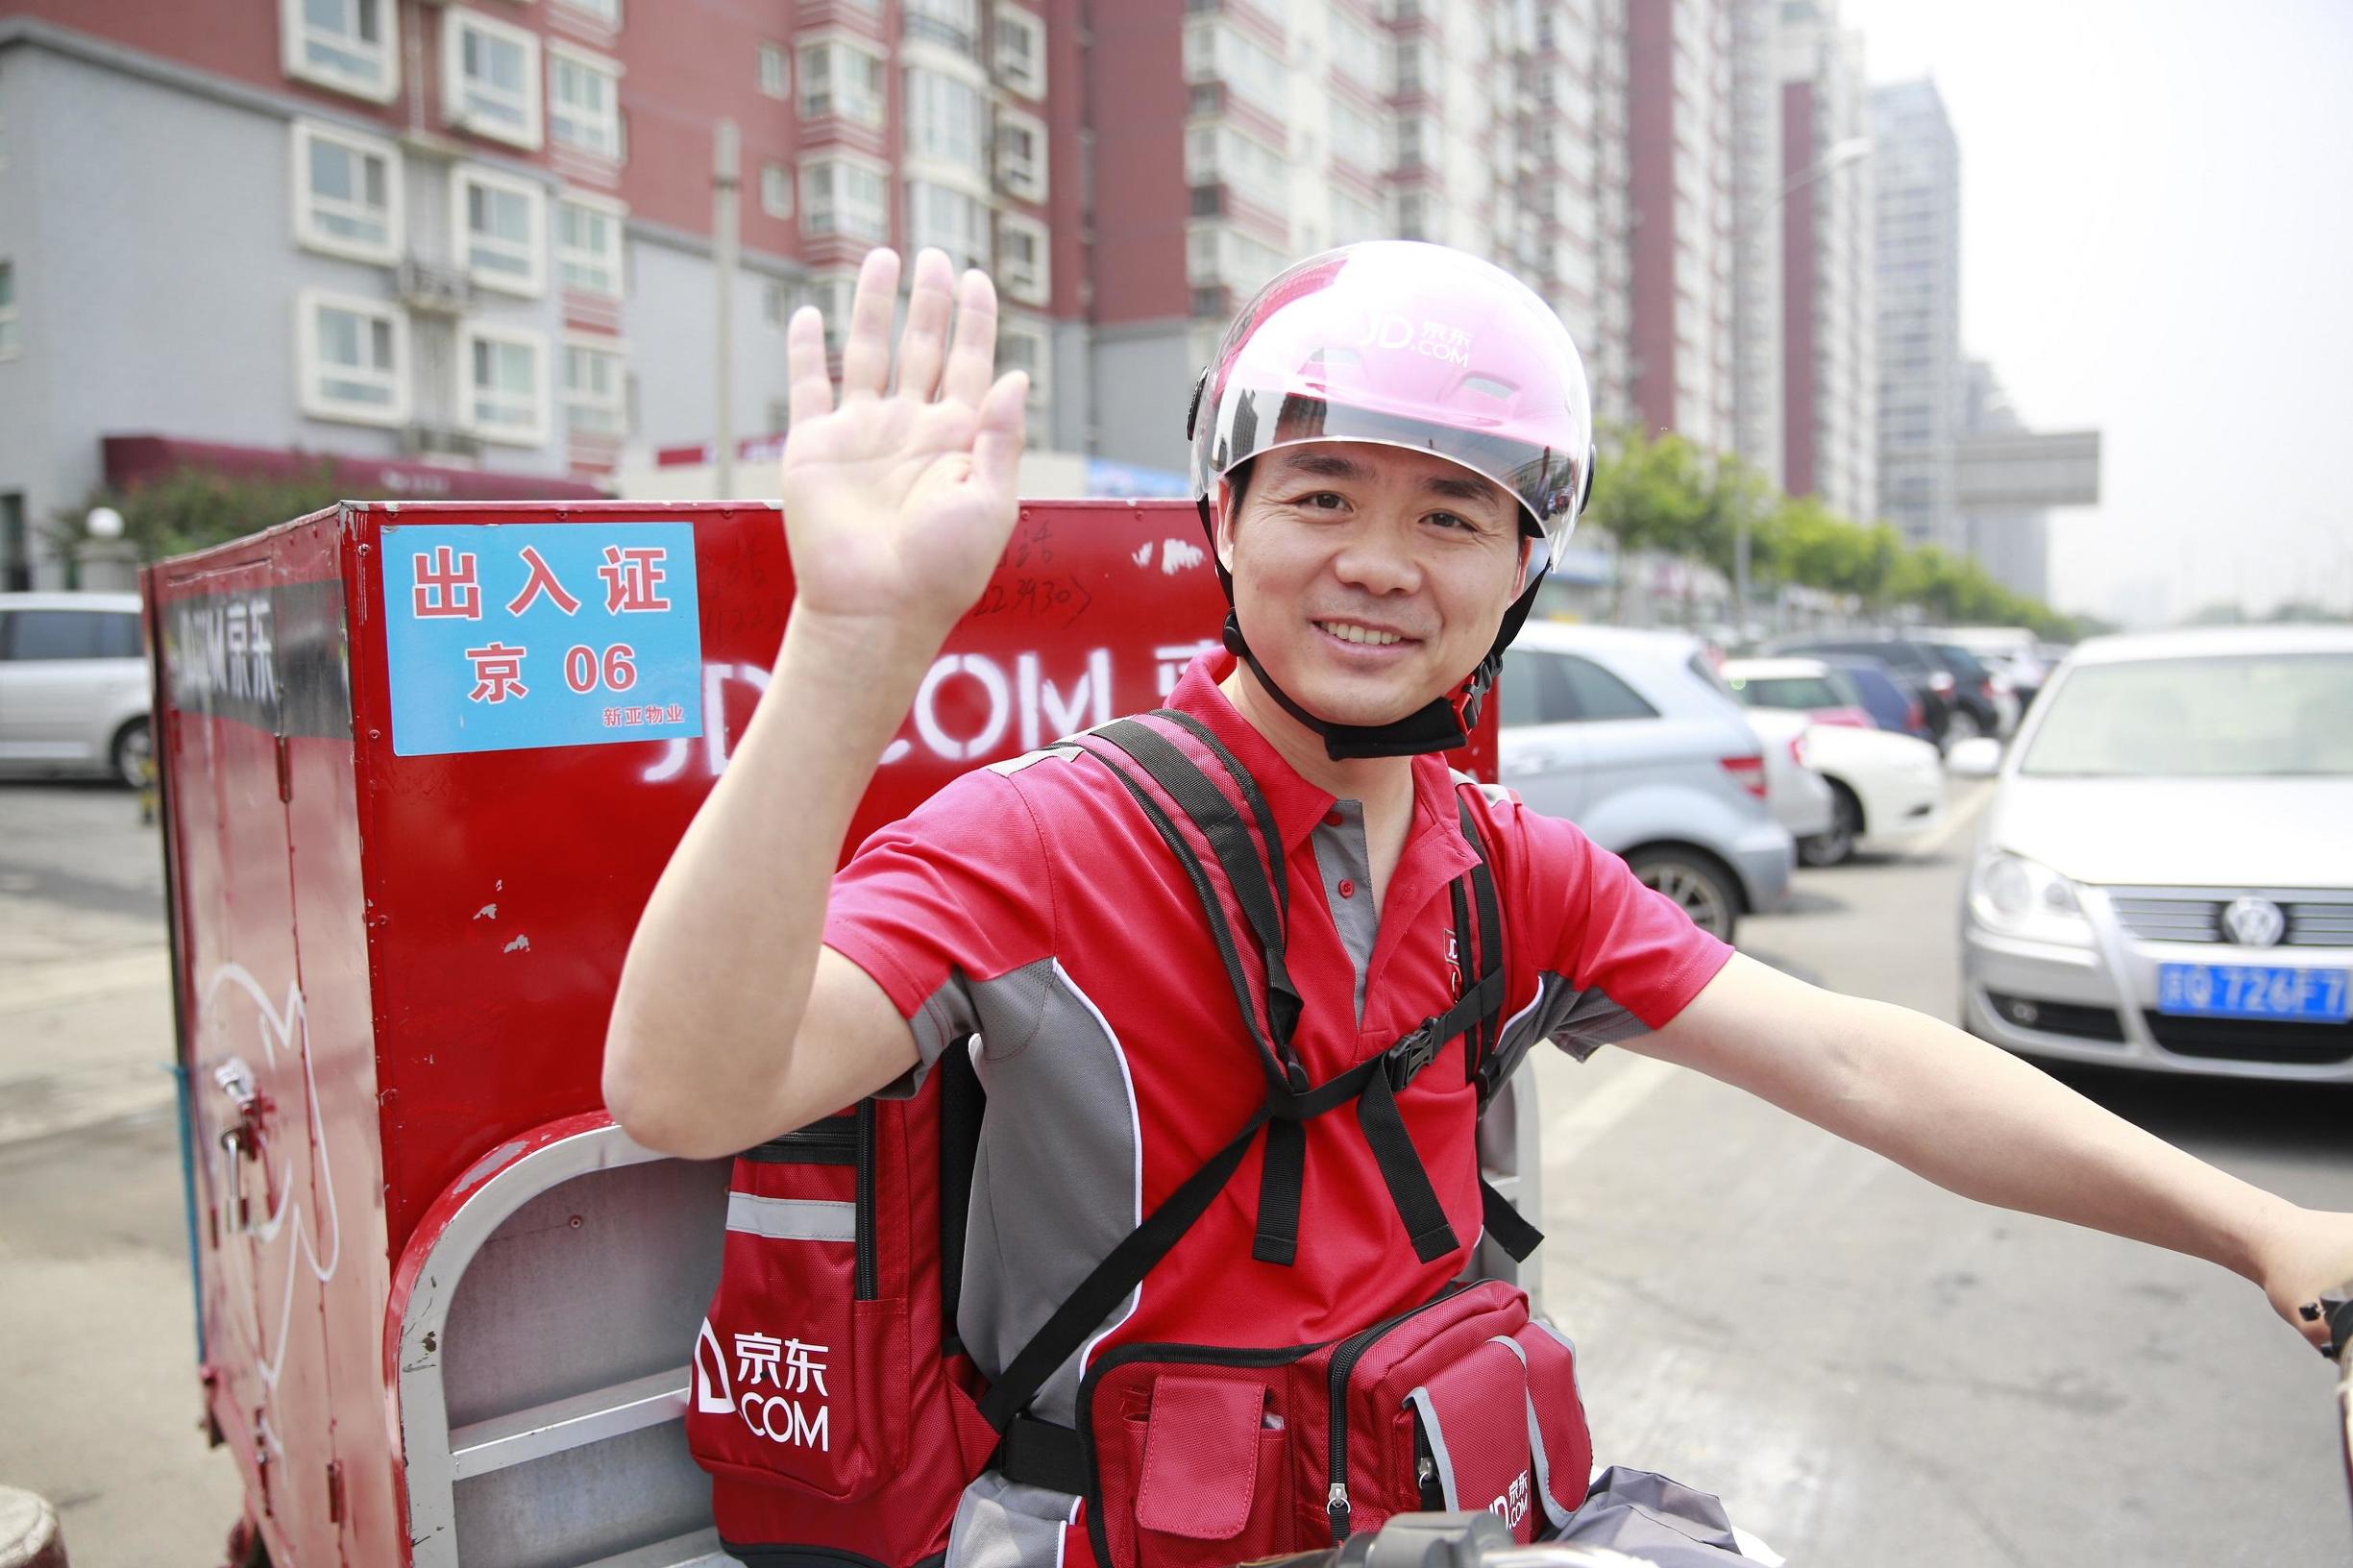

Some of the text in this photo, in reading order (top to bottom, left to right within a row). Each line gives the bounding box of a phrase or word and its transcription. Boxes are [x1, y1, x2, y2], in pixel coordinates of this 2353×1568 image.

[413, 546, 671, 620] 出入证
[465, 643, 637, 703] 京 06
[602, 704, 684, 728] 新亚物业
[734, 1332, 829, 1397] 京东
[1508, 1469, 1528, 1507] 京东
